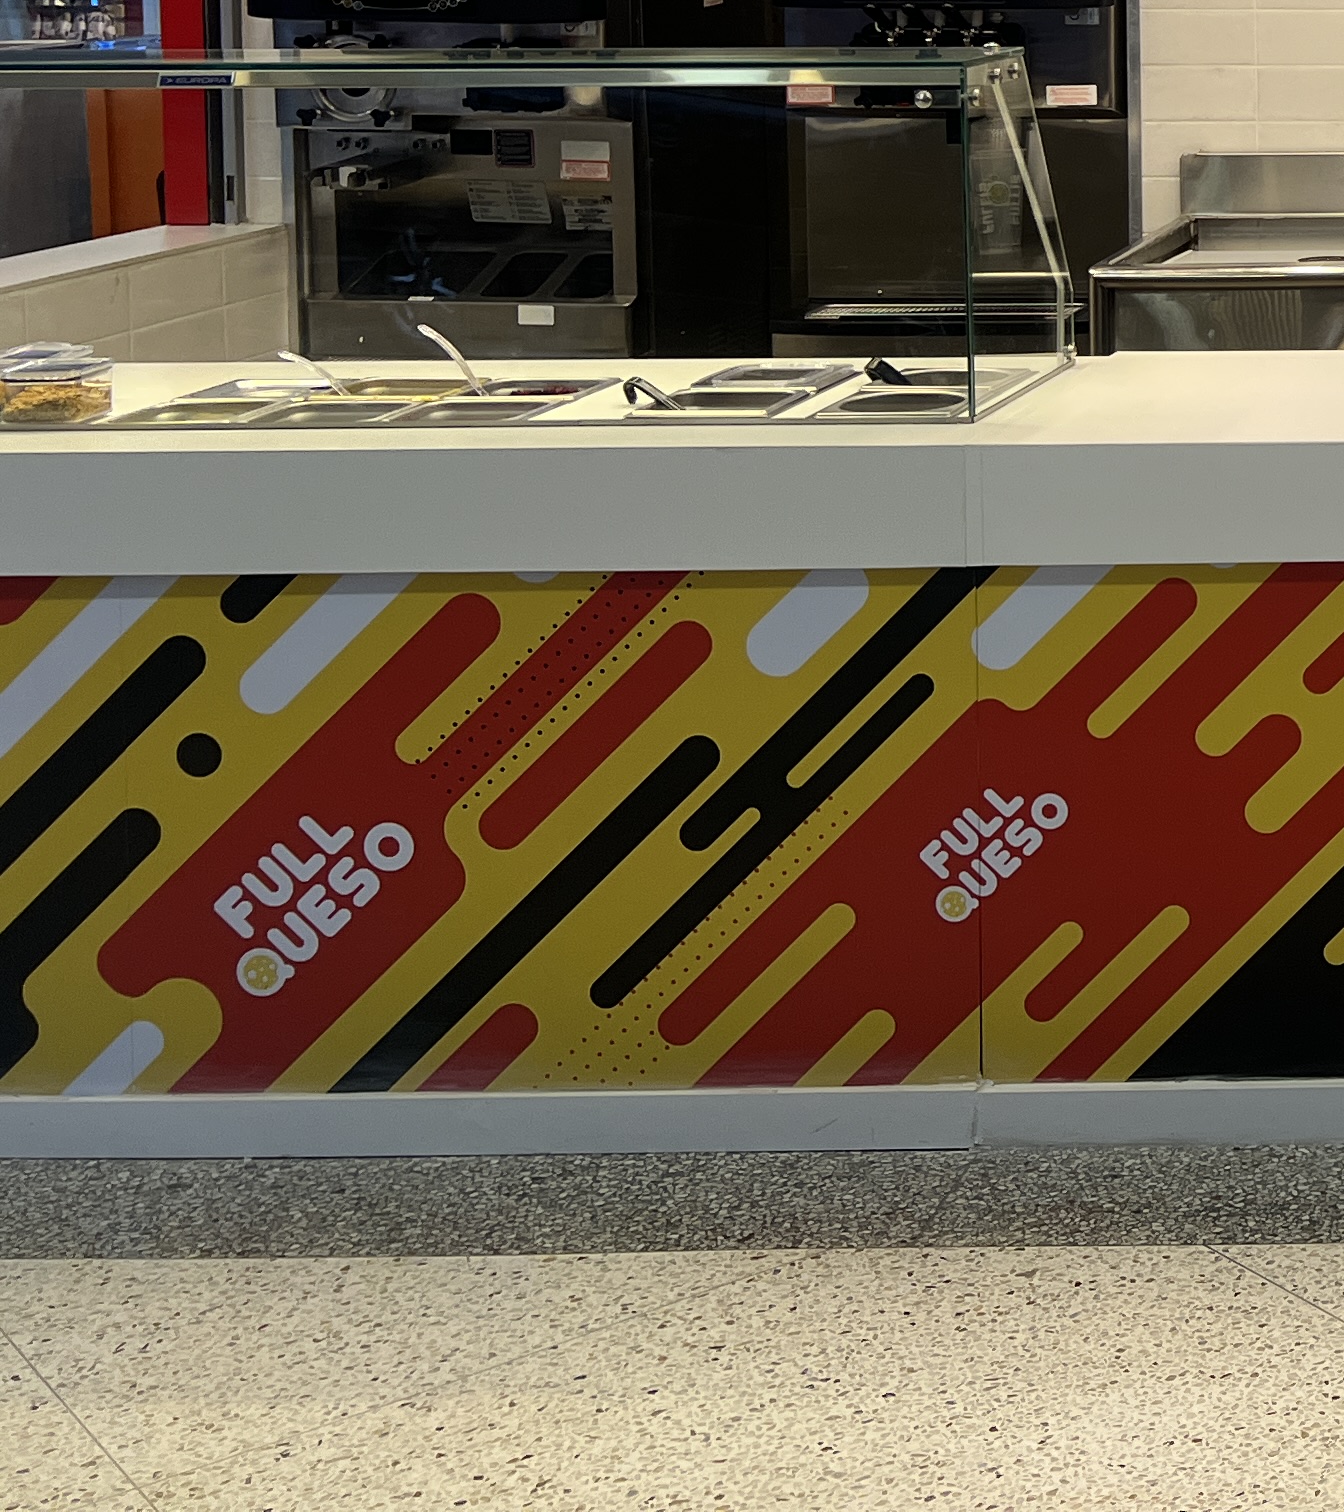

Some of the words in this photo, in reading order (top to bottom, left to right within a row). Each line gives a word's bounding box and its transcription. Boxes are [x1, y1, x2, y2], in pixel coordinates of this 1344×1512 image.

[213, 815, 355, 939] FULL
[919, 788, 1025, 879] FULL
[935, 792, 1069, 922] QUESO
[236, 821, 415, 997] QUESO
